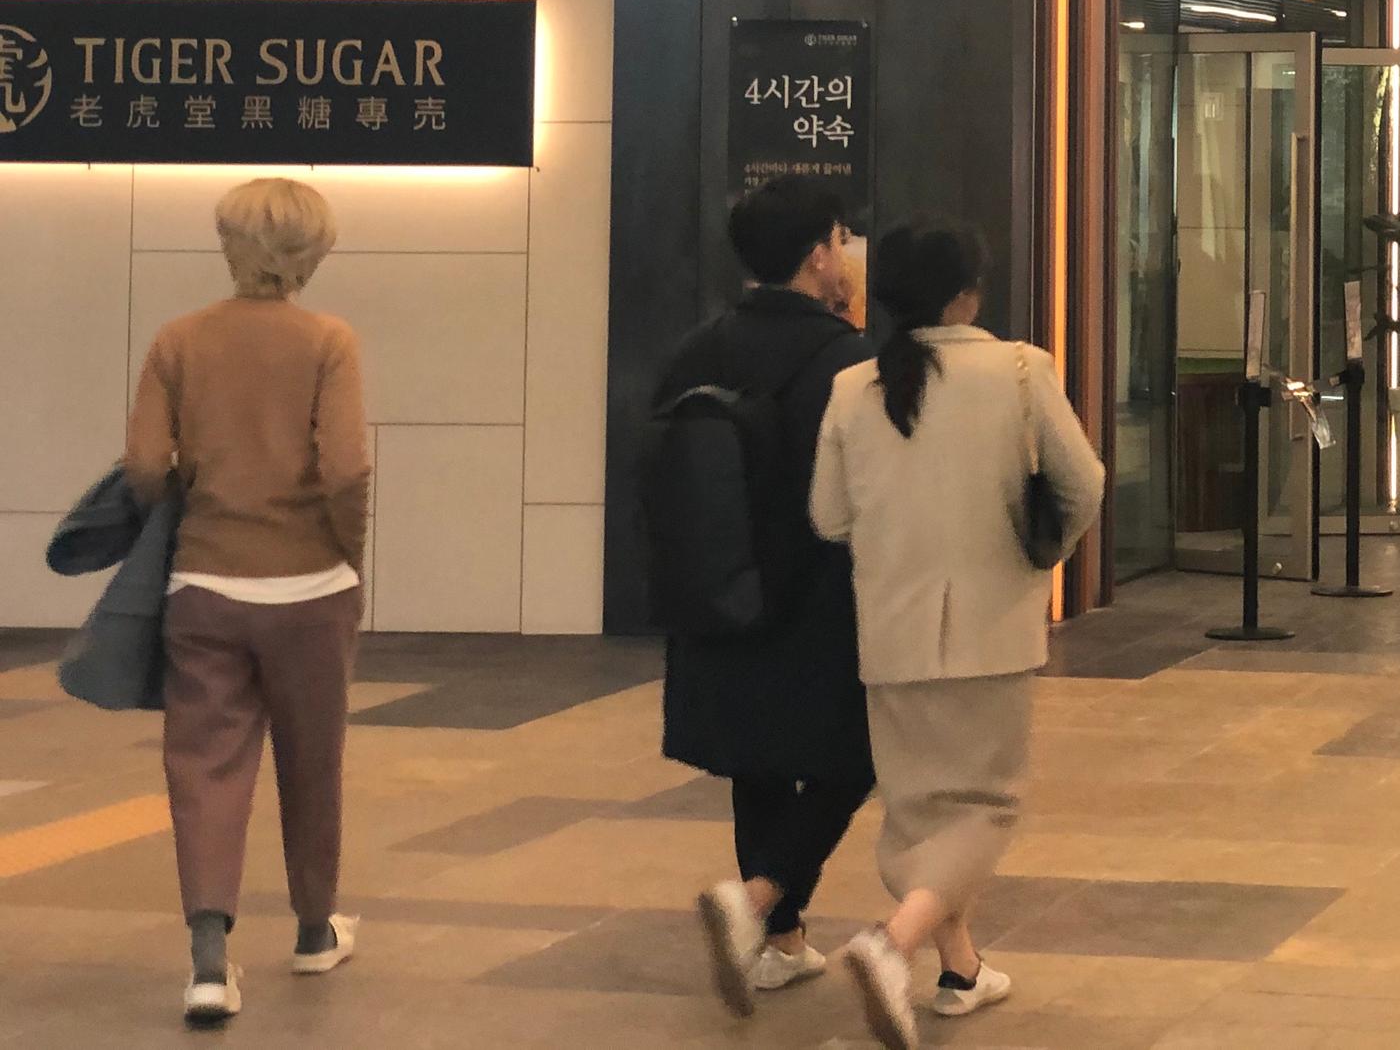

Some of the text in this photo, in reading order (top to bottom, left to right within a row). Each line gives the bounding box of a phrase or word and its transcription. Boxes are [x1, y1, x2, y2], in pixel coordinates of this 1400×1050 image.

[72, 37, 235, 85] TIGER
[255, 37, 446, 86] SUGAR
[744, 74, 853, 110] 4시간의
[793, 114, 855, 149] 약속
